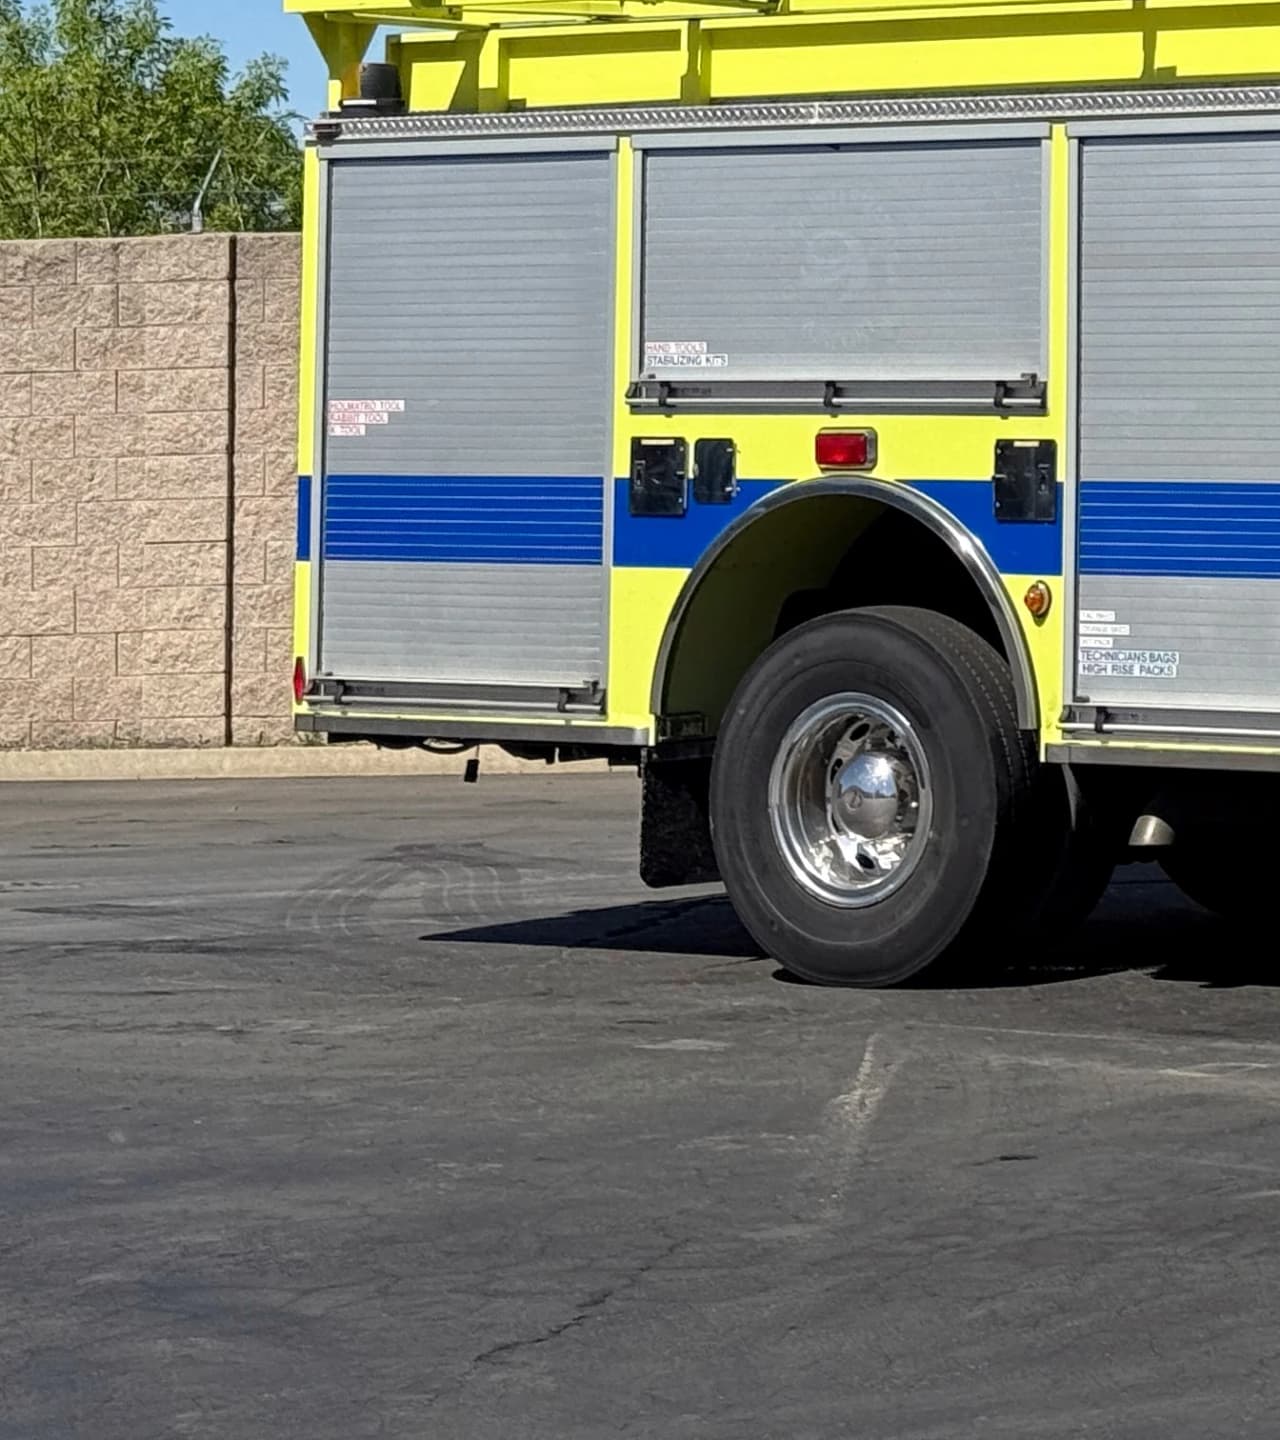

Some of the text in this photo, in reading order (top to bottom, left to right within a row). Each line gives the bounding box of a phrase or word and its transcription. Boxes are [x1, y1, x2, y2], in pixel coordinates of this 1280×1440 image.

[646, 343, 705, 353] HAND TOOLS
[646, 356, 727, 366] STABILIZING KITS
[1080, 650, 1177, 663] TECHNICIANS BAGS
[1082, 664, 1174, 676] HIGH RISE PACKS
